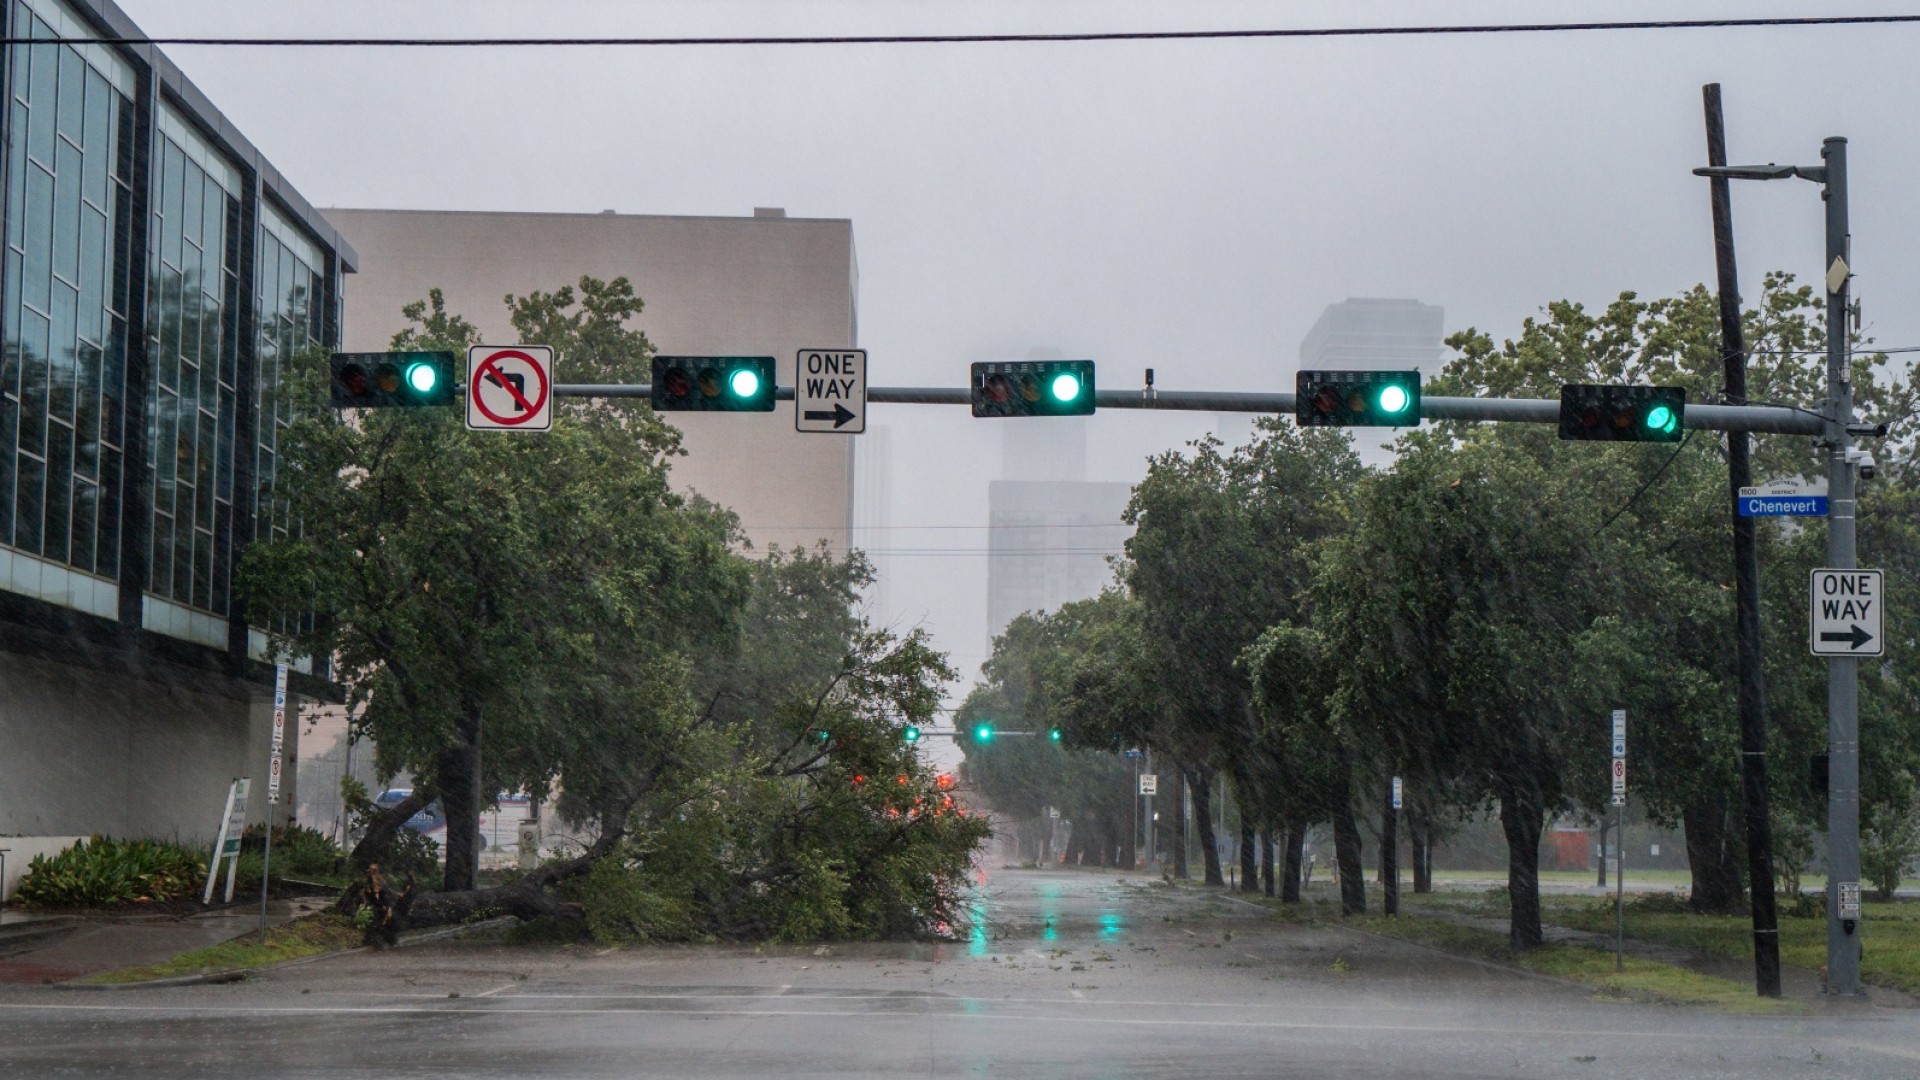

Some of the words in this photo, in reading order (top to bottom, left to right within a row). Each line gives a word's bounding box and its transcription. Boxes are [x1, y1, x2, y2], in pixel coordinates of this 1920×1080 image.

[807, 353, 855, 375] ONE
[807, 378, 856, 399] WAY
[1749, 499, 1816, 513] Chenevert
[1823, 574, 1871, 596] ONE
[1822, 599, 1872, 620] WAY
